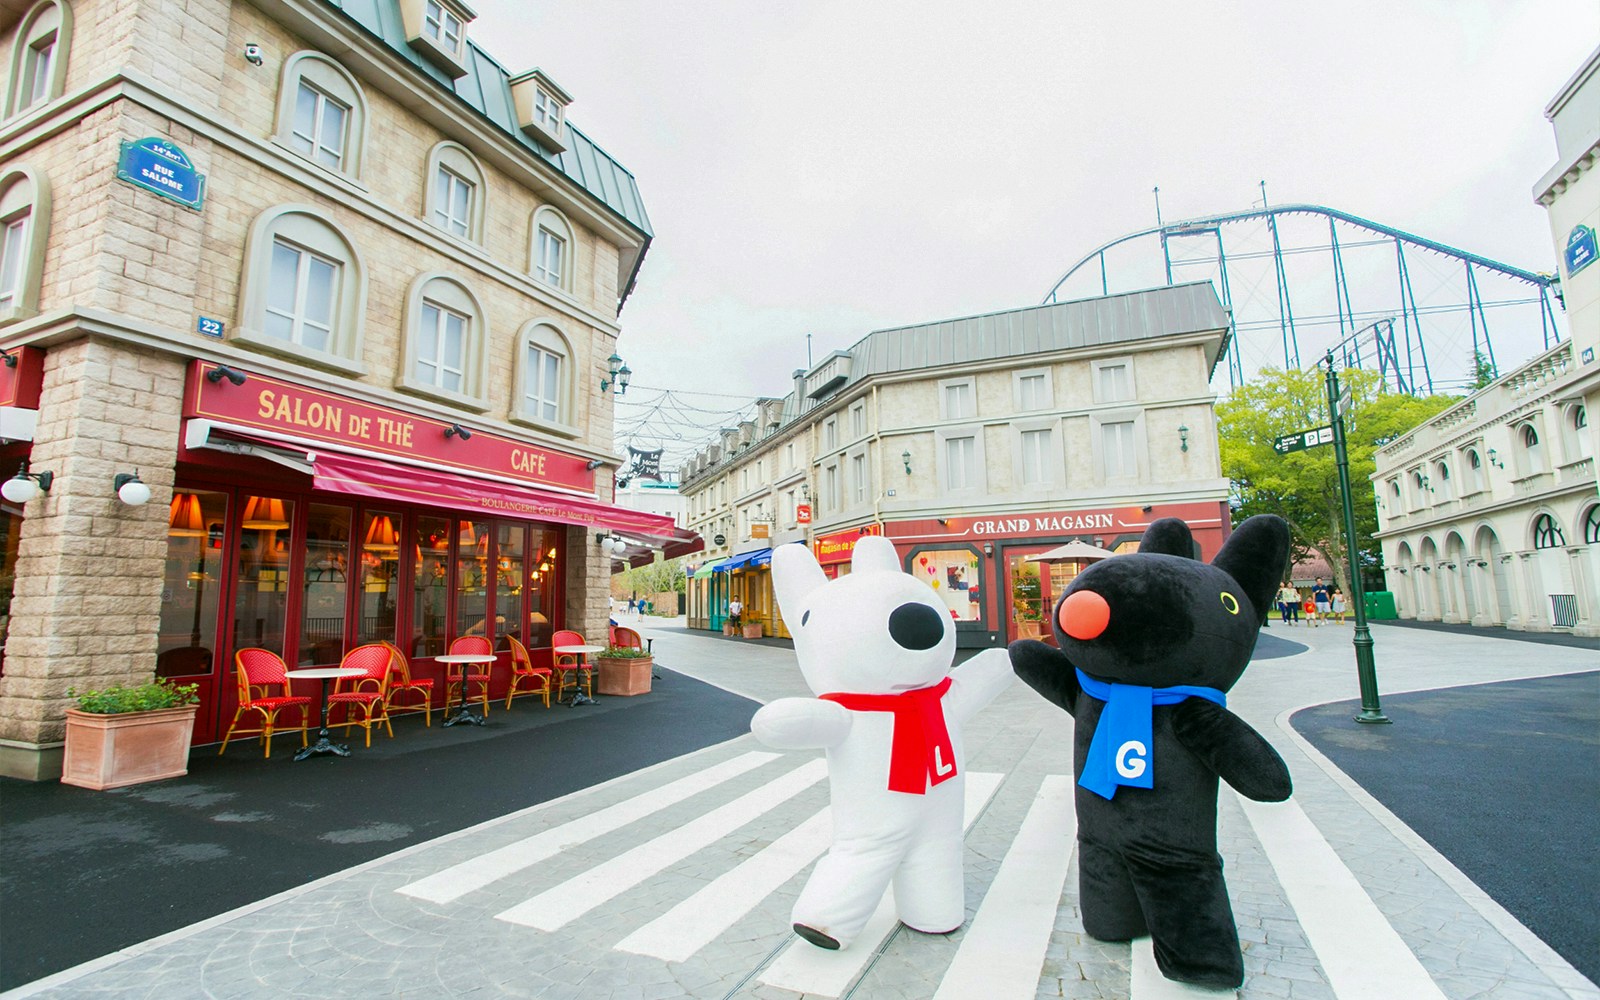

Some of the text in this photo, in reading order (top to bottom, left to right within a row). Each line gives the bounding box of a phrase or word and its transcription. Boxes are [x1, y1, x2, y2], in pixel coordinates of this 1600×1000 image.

[142, 168, 184, 192] SALOME
[154, 164, 174, 178] RUE
[202, 320, 220, 334] 22
[258, 390, 414, 448] SALON DE THÉ
[511, 448, 546, 476] CAFÉ
[482, 498, 537, 514] BOULANGERIE
[538, 506, 556, 516] CAFÉ
[558, 509, 566, 518] Le
[568, 510, 582, 520] Mont
[973, 514, 1113, 534] GRAND MAGASIN
[935, 745, 952, 777] L
[1115, 740, 1146, 778] G
